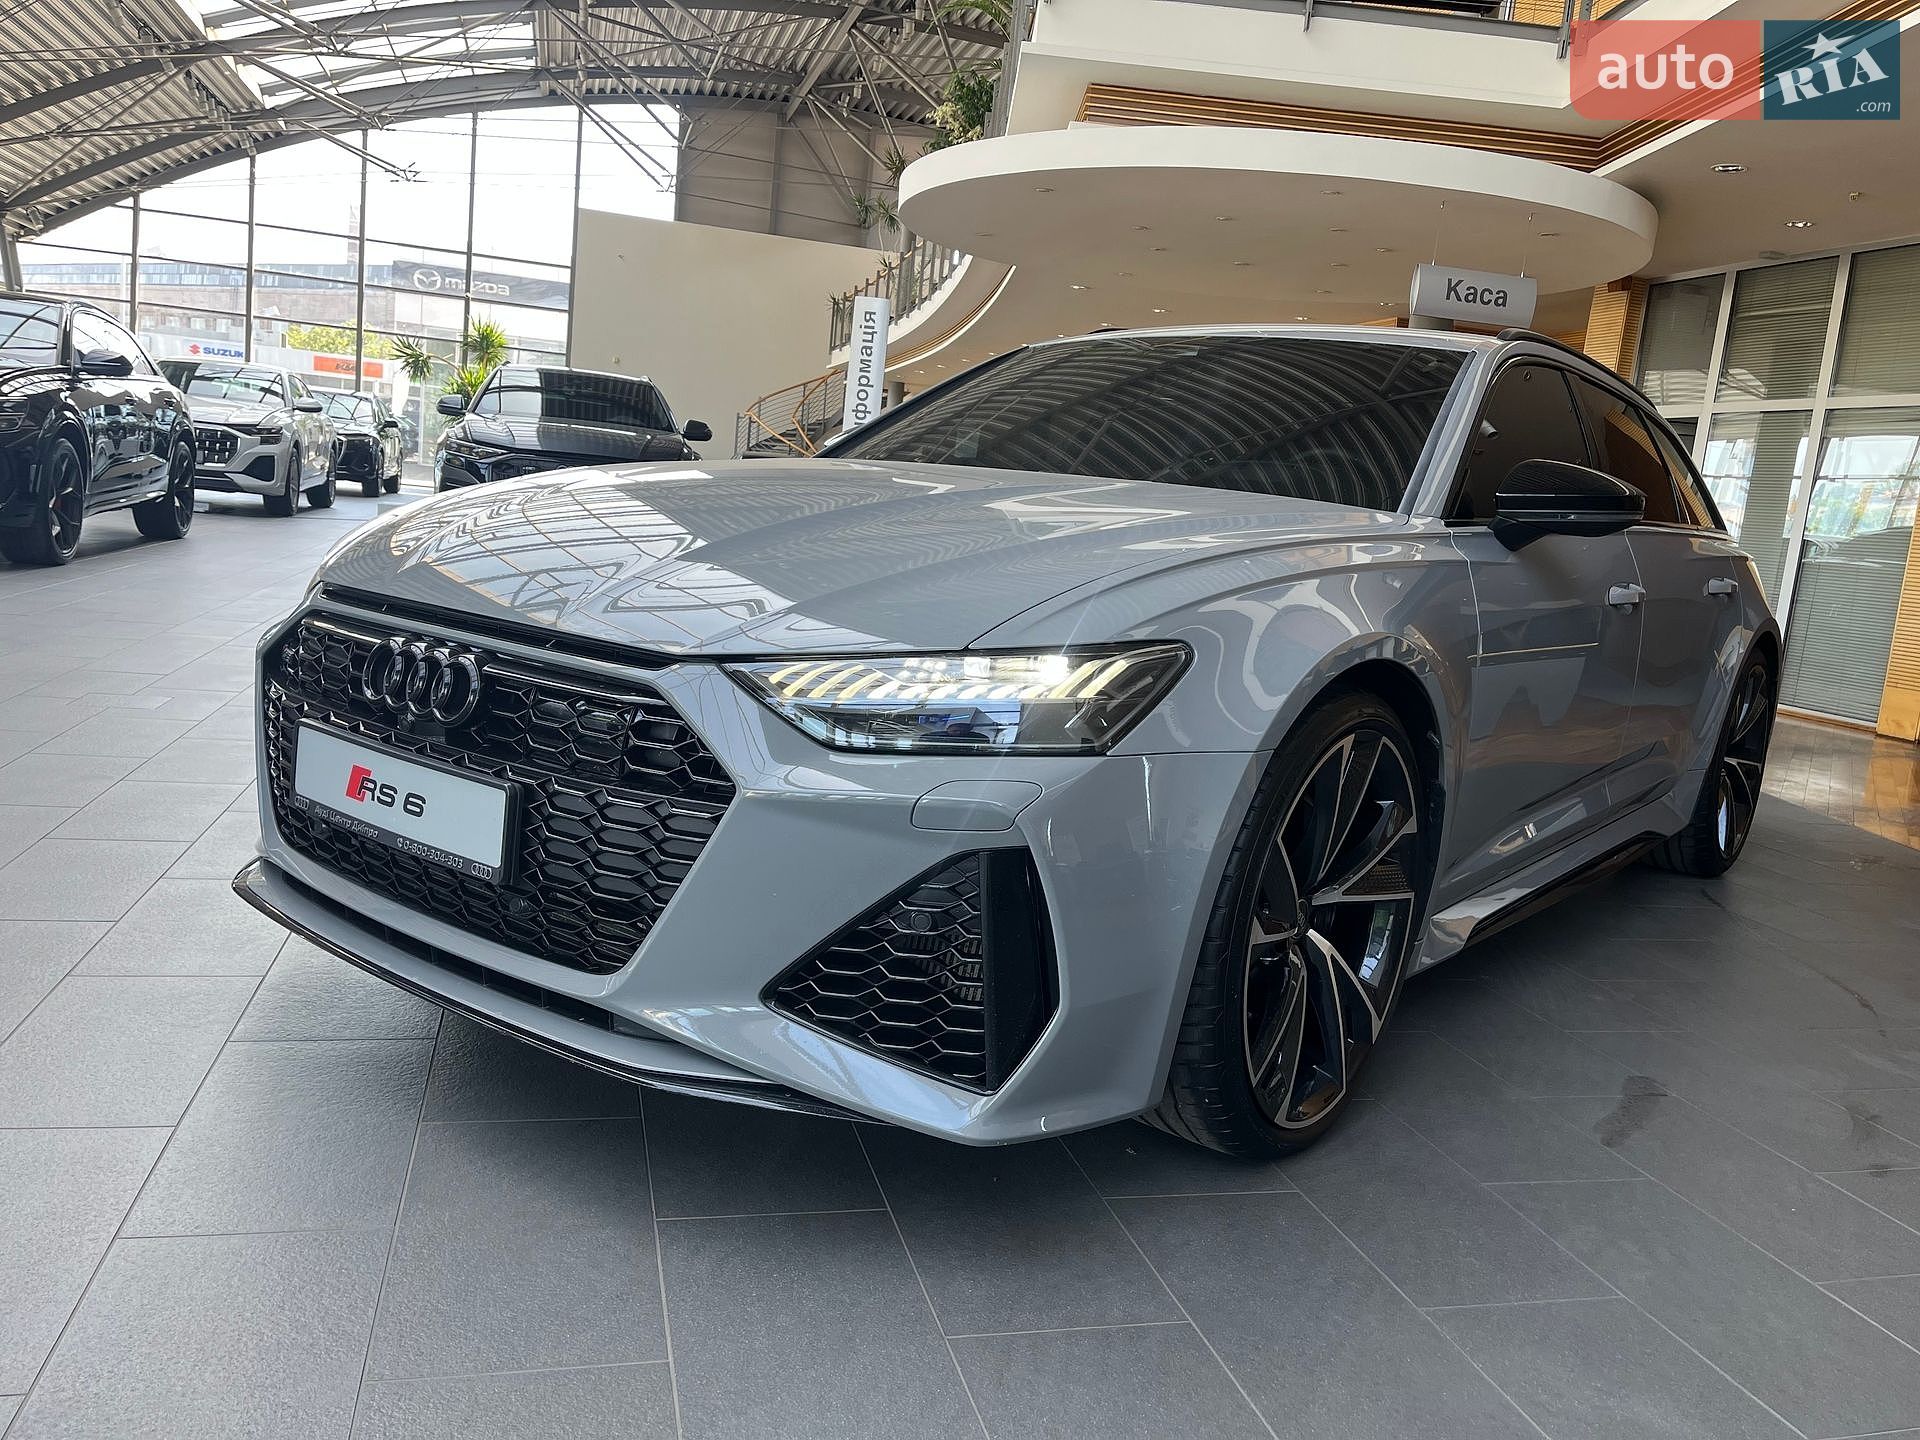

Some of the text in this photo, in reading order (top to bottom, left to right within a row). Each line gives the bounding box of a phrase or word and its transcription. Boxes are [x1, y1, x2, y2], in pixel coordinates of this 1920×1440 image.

[1445, 278, 1508, 308] Каса
[203, 346, 244, 358] SUZUK
[852, 311, 877, 425] формація
[357, 776, 427, 818] RS 6
